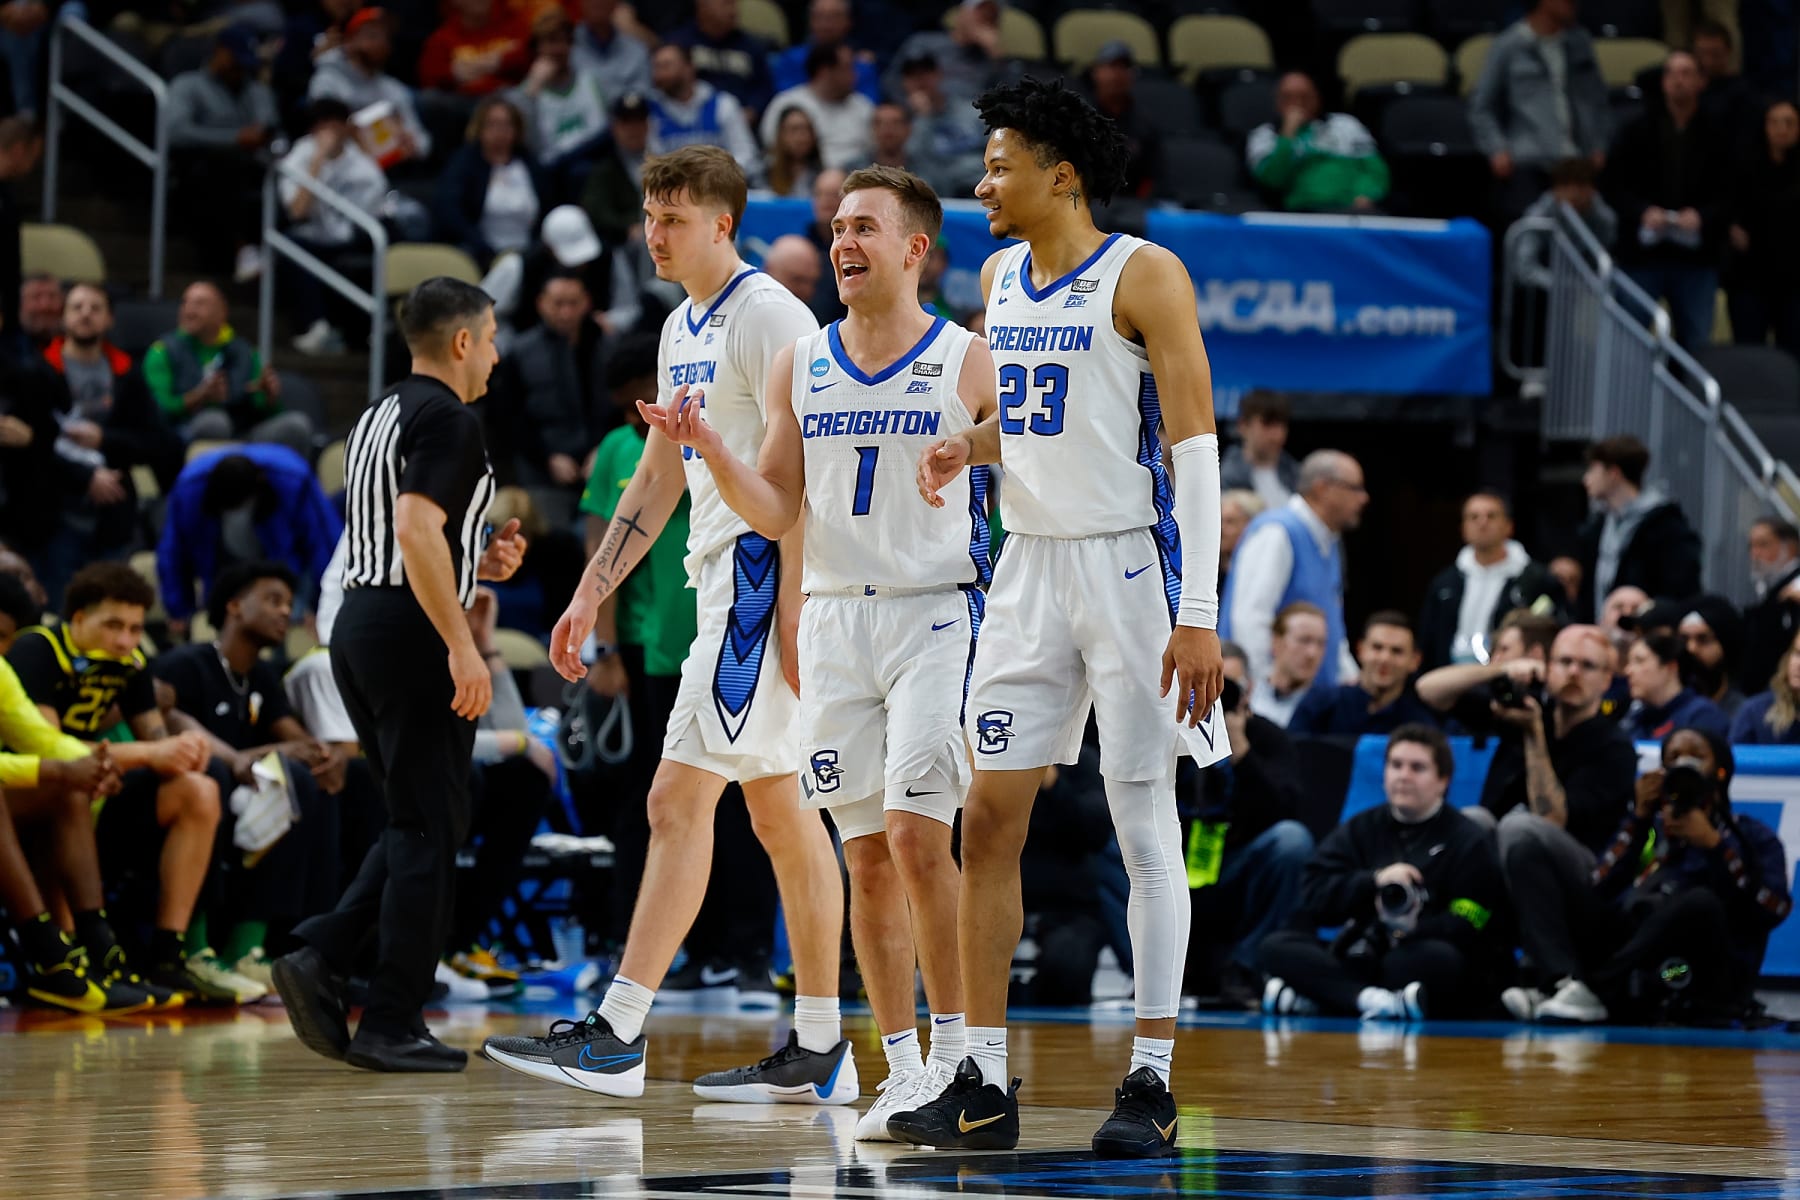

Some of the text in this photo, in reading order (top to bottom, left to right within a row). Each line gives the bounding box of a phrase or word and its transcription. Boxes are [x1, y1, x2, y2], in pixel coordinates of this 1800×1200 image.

[989, 325, 1094, 352] CREIGHTON
[803, 410, 942, 439] CREIGHTON
[998, 362, 1070, 437] 23
[851, 445, 880, 517] 1
